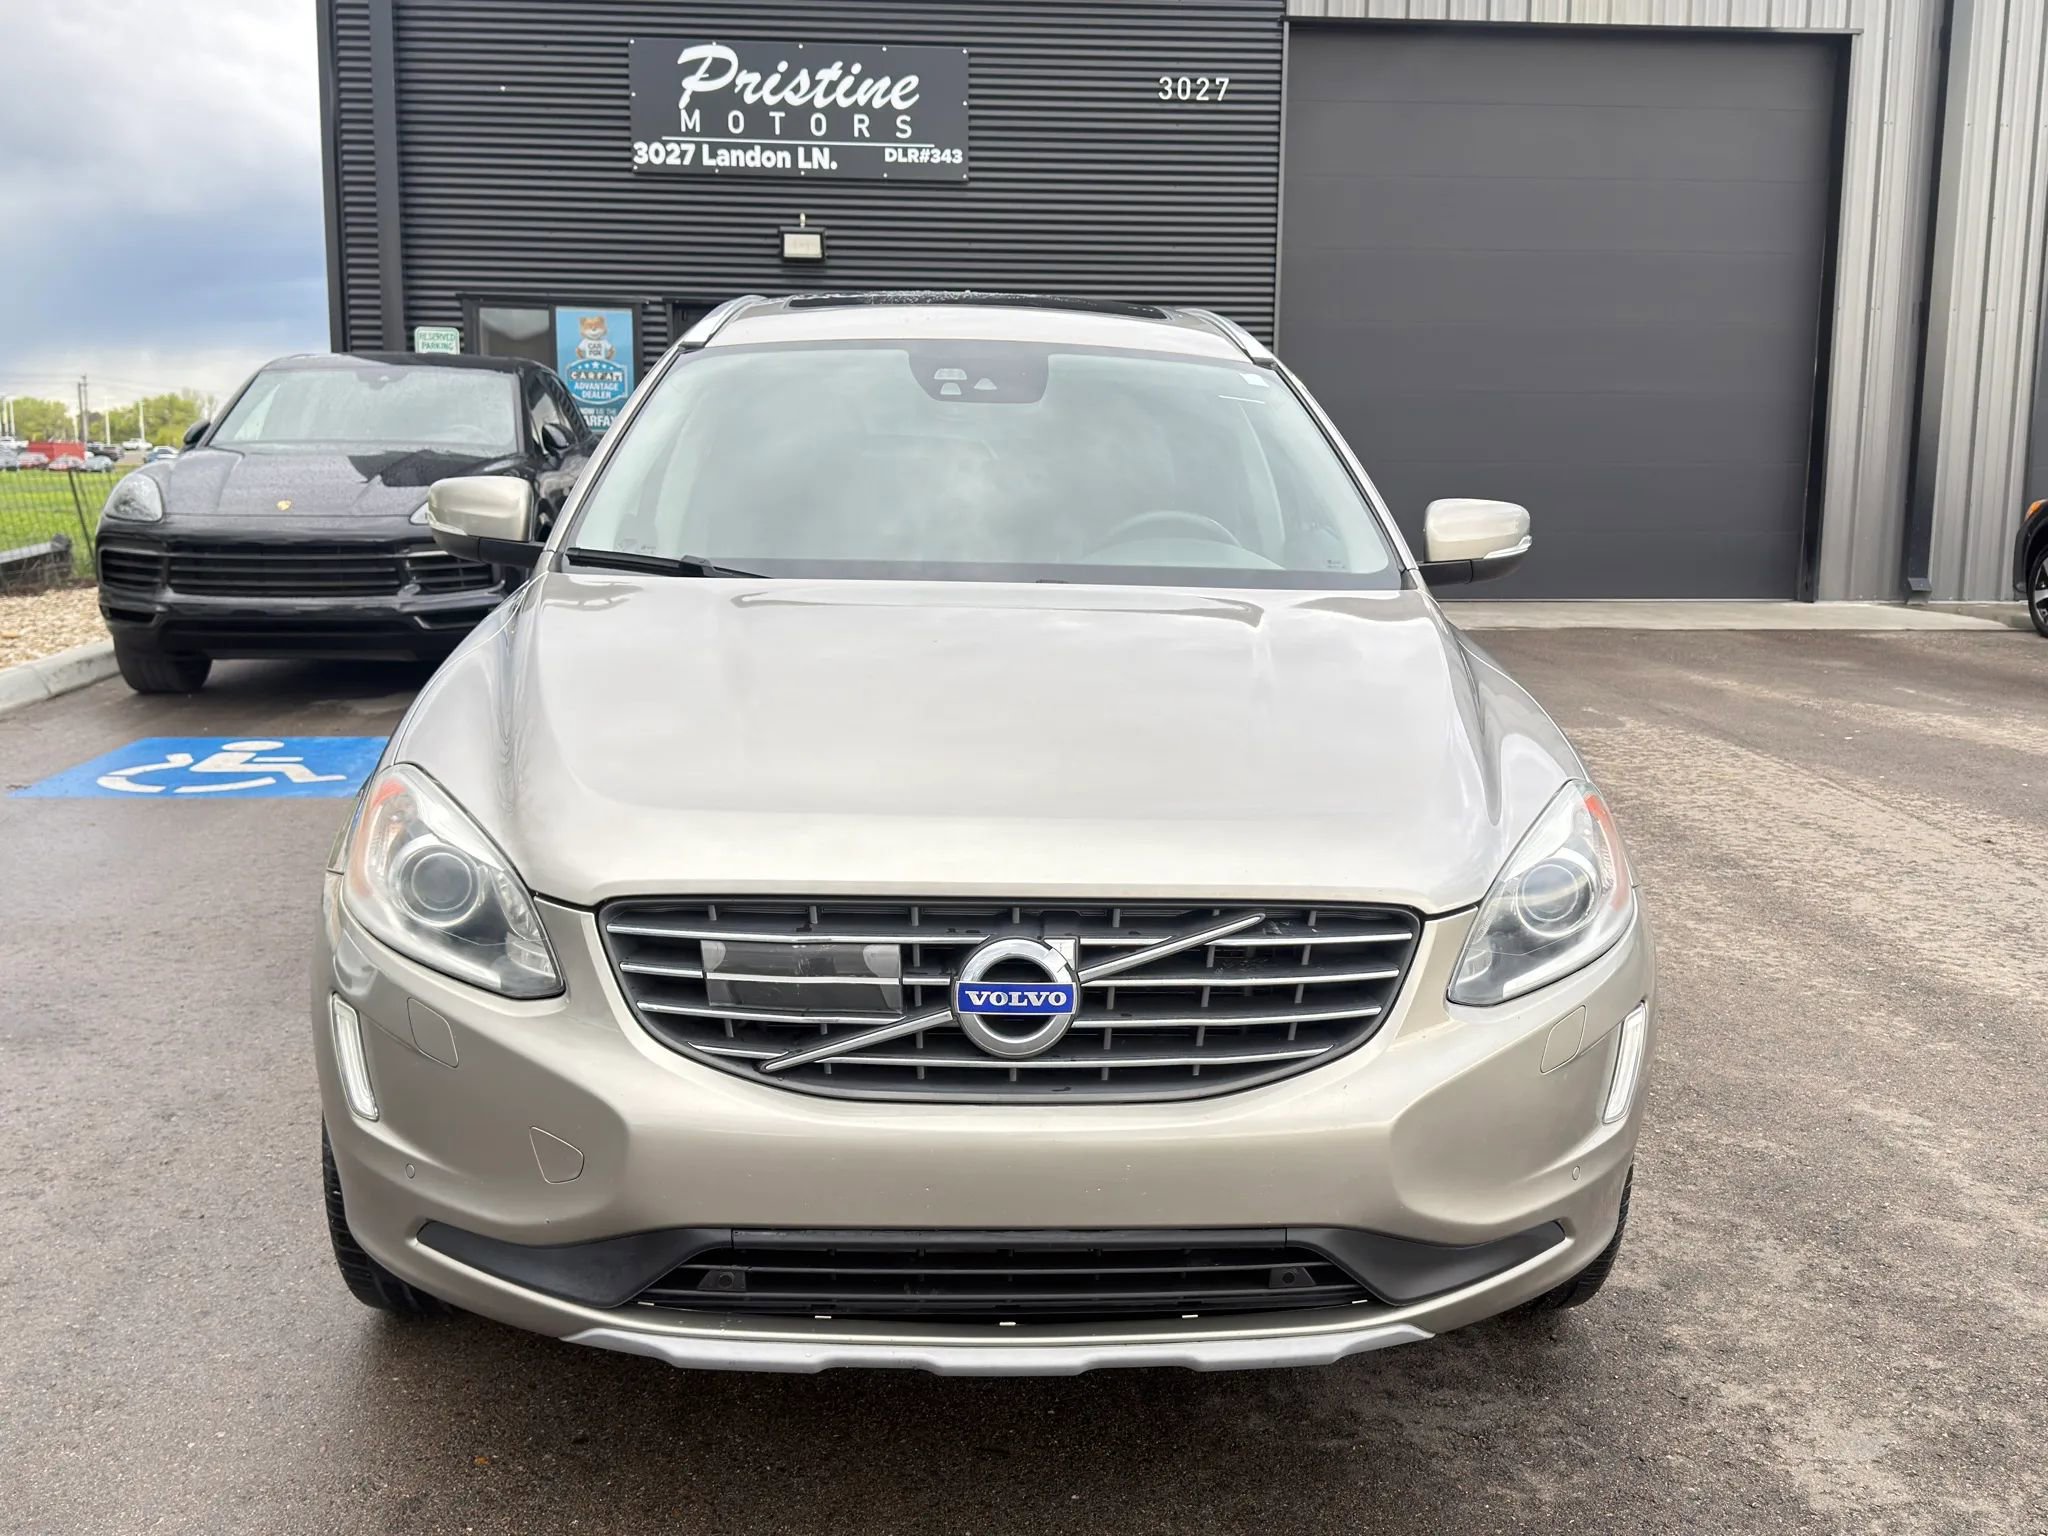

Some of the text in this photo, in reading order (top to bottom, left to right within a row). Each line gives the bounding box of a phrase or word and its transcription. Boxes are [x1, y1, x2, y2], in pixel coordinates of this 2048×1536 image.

[677, 44, 920, 110] Pristine
[1158, 76, 1230, 101] 3027
[680, 109, 912, 139] MOTORS
[633, 142, 838, 169] 3027 Landon LN.
[884, 148, 963, 164] DLR#343
[419, 332, 456, 341] RESERVED
[421, 341, 454, 351] PARKING
[570, 371, 623, 382] CARFAX
[574, 381, 619, 391] ADVANTAGE
[581, 390, 612, 399] DEALER
[965, 990, 1067, 1006] VOLVO
